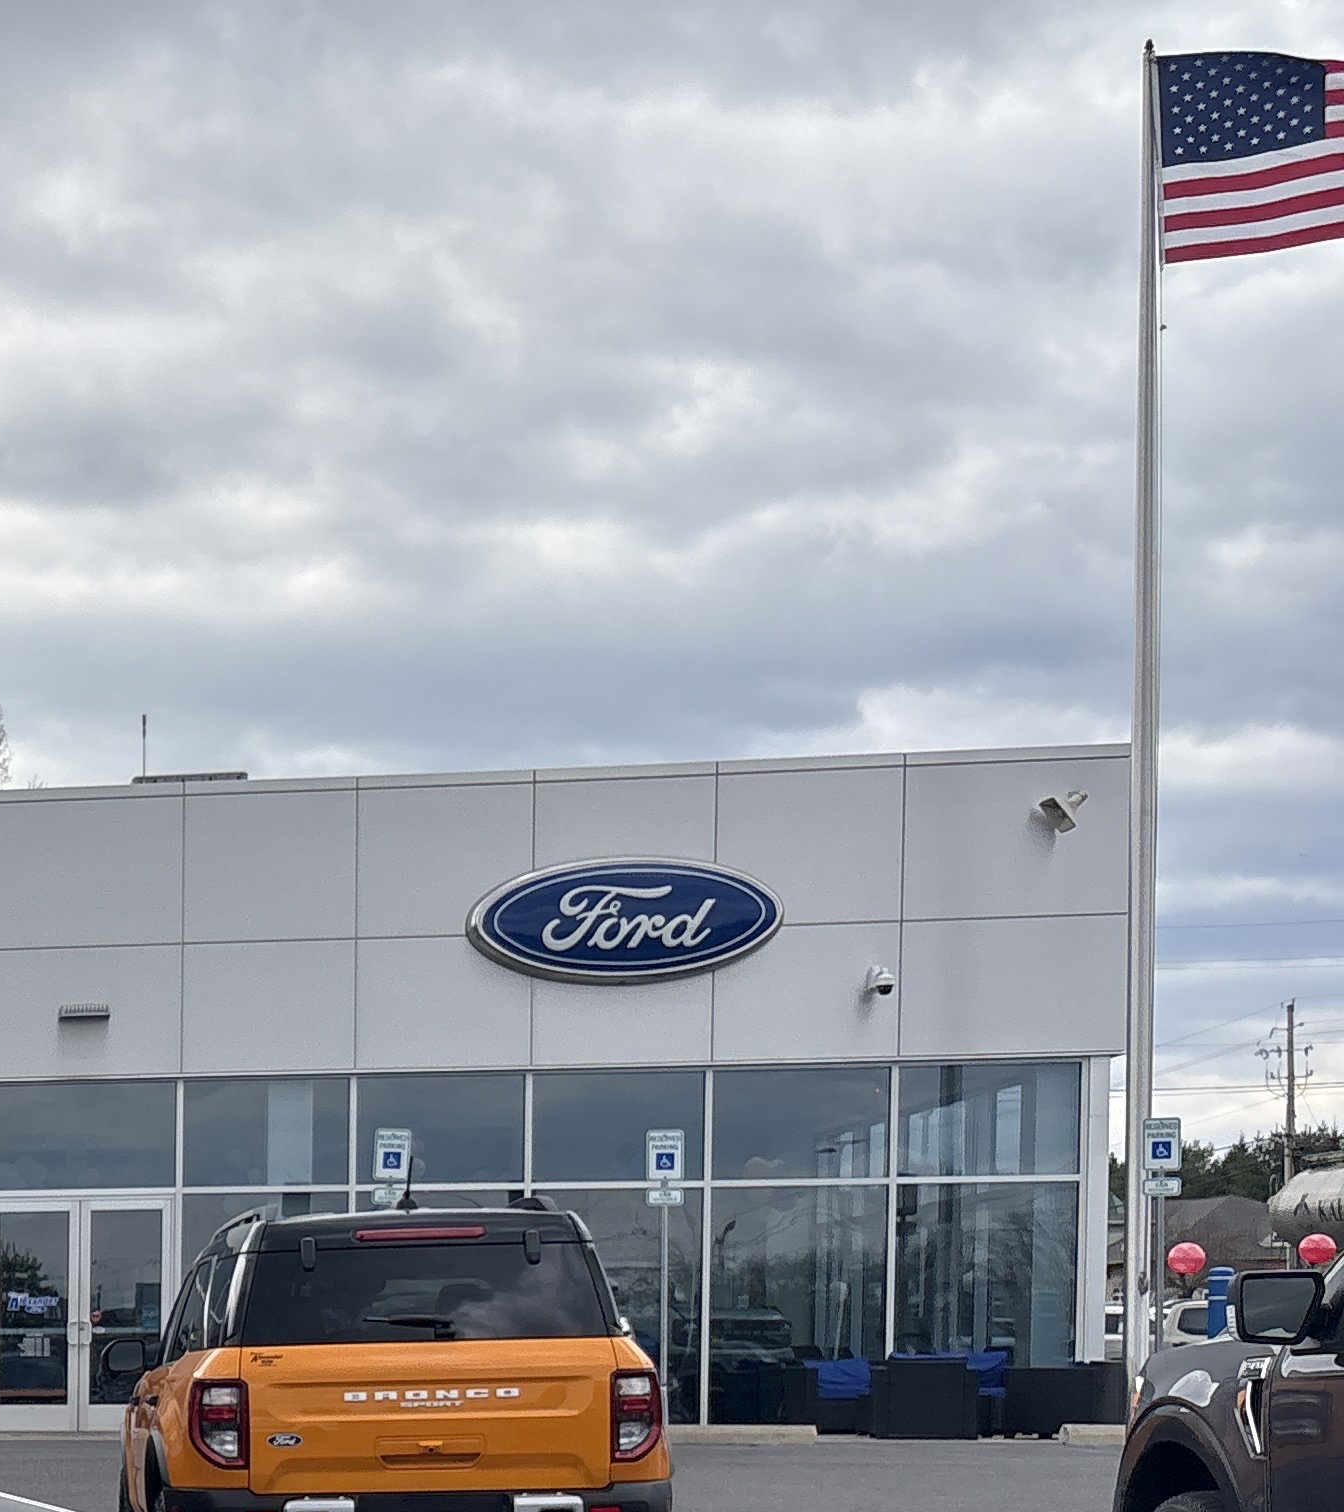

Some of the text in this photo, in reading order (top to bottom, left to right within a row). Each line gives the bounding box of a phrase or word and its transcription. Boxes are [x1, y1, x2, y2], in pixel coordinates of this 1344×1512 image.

[541, 885, 717, 953] Ford
[343, 1387, 520, 1402] BRONCO
[400, 1400, 463, 1408] SPORT
[272, 1434, 298, 1446] Ford
